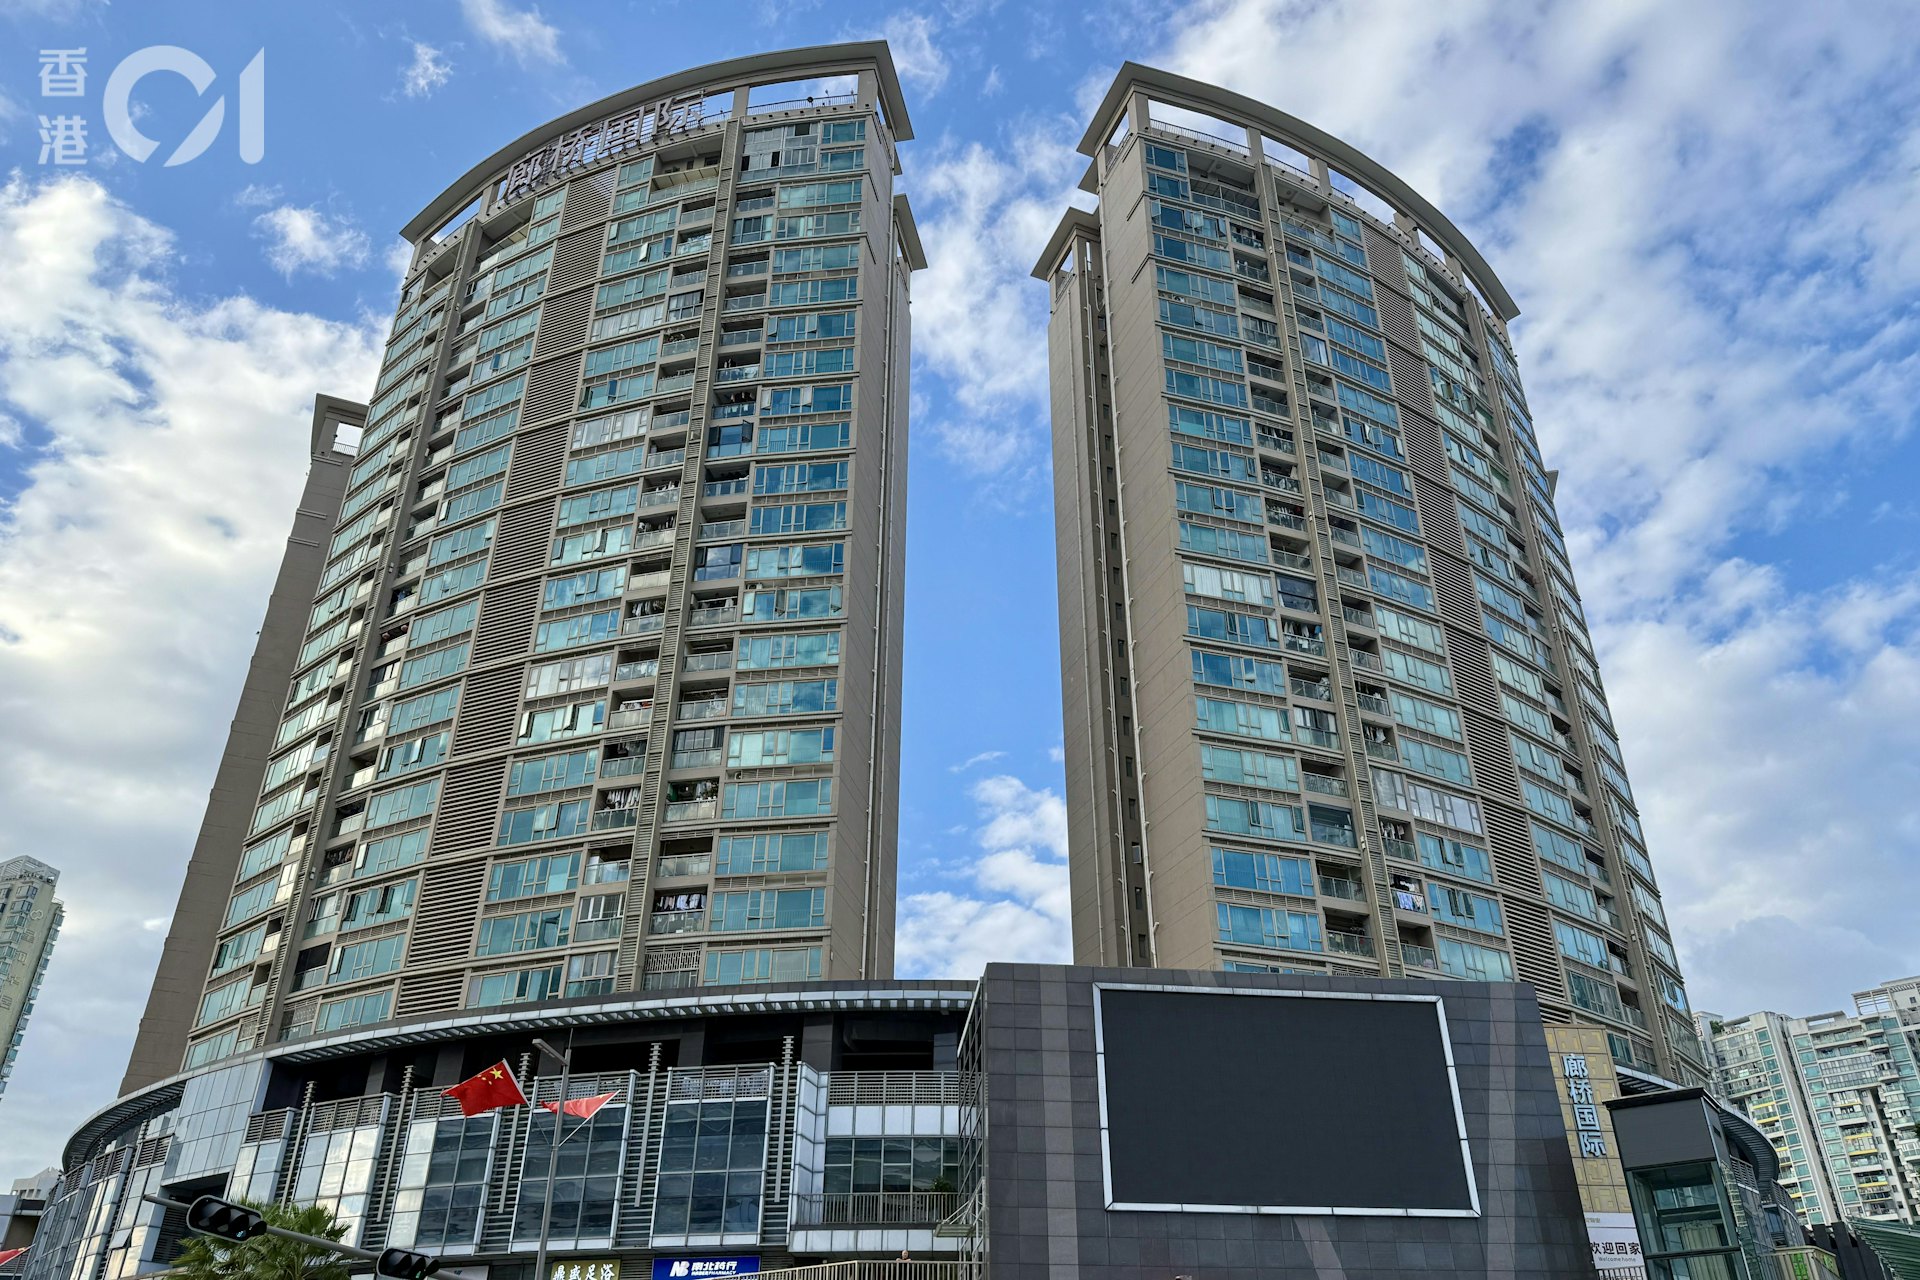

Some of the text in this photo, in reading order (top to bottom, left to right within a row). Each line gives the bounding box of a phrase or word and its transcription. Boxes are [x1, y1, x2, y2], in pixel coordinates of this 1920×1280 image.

[502, 90, 703, 201] 廊桥国际
[1562, 1053, 1606, 1158] 廊桥国际
[1590, 1241, 1641, 1255] 欢迎回家
